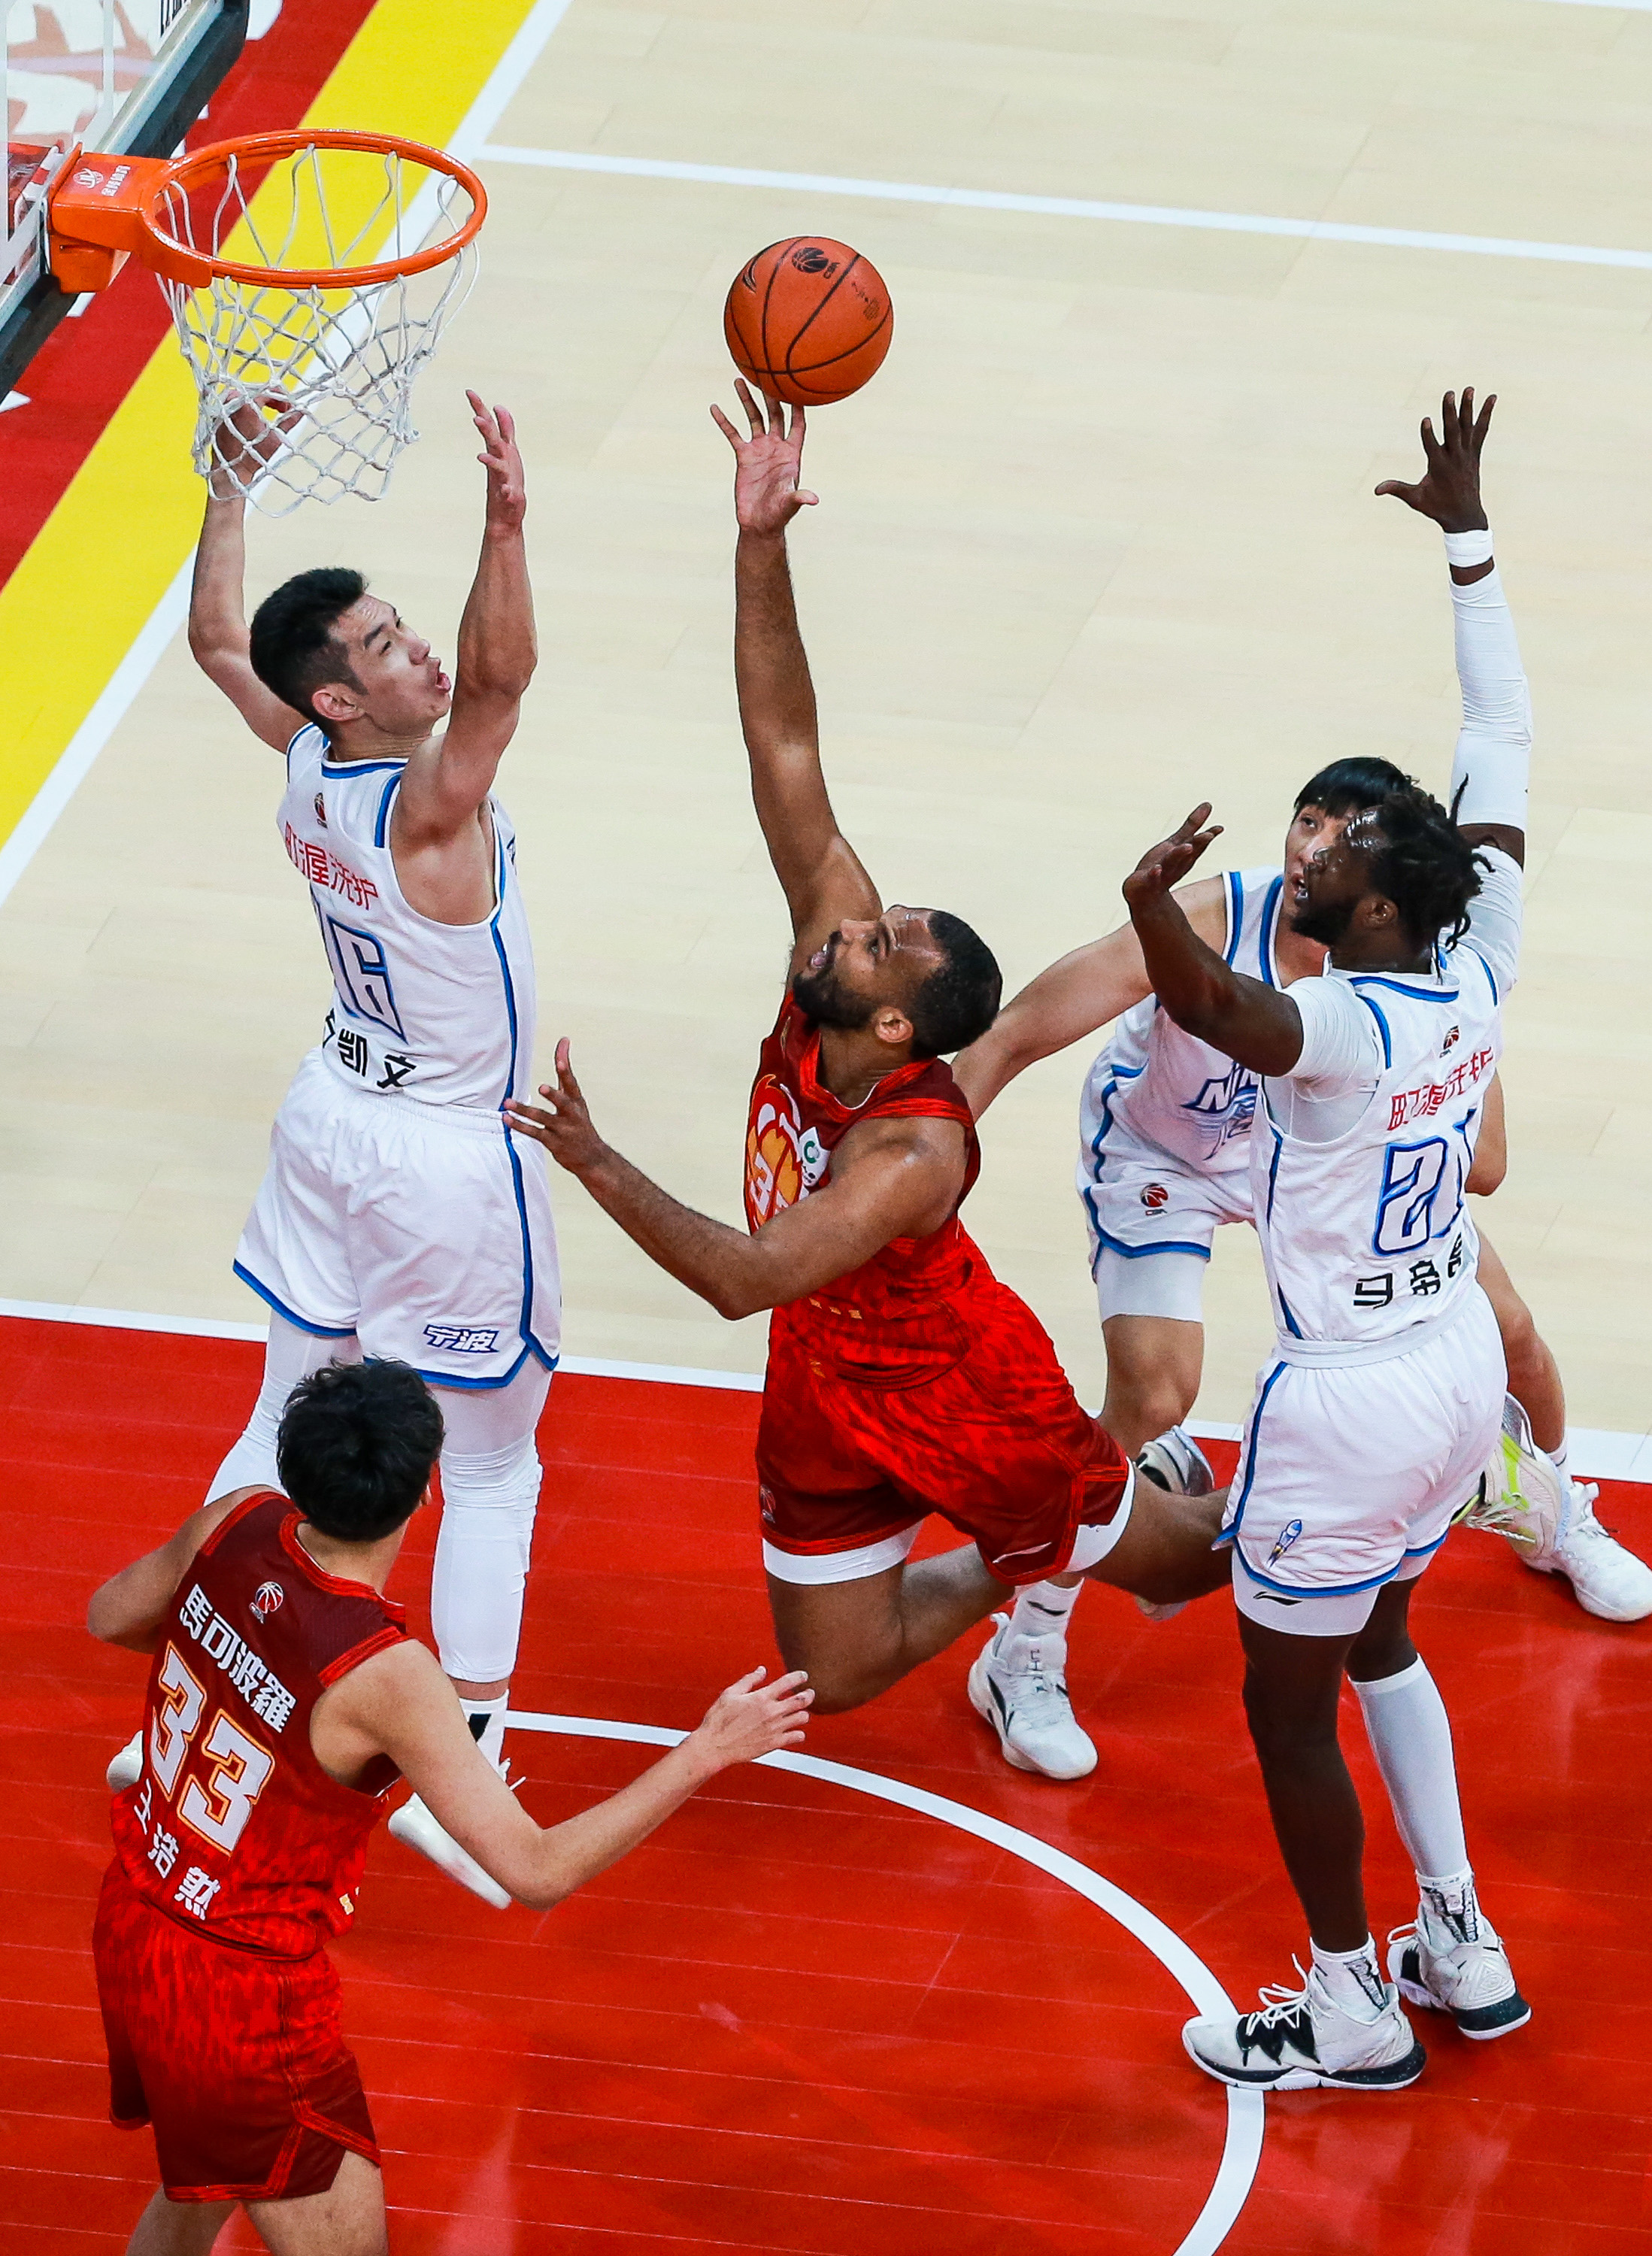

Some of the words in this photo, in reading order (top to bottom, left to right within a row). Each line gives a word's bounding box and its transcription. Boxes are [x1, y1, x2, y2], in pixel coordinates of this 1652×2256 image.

[150, 1640, 276, 1857] 33
[180, 1584, 297, 1733] 馬可波羅
